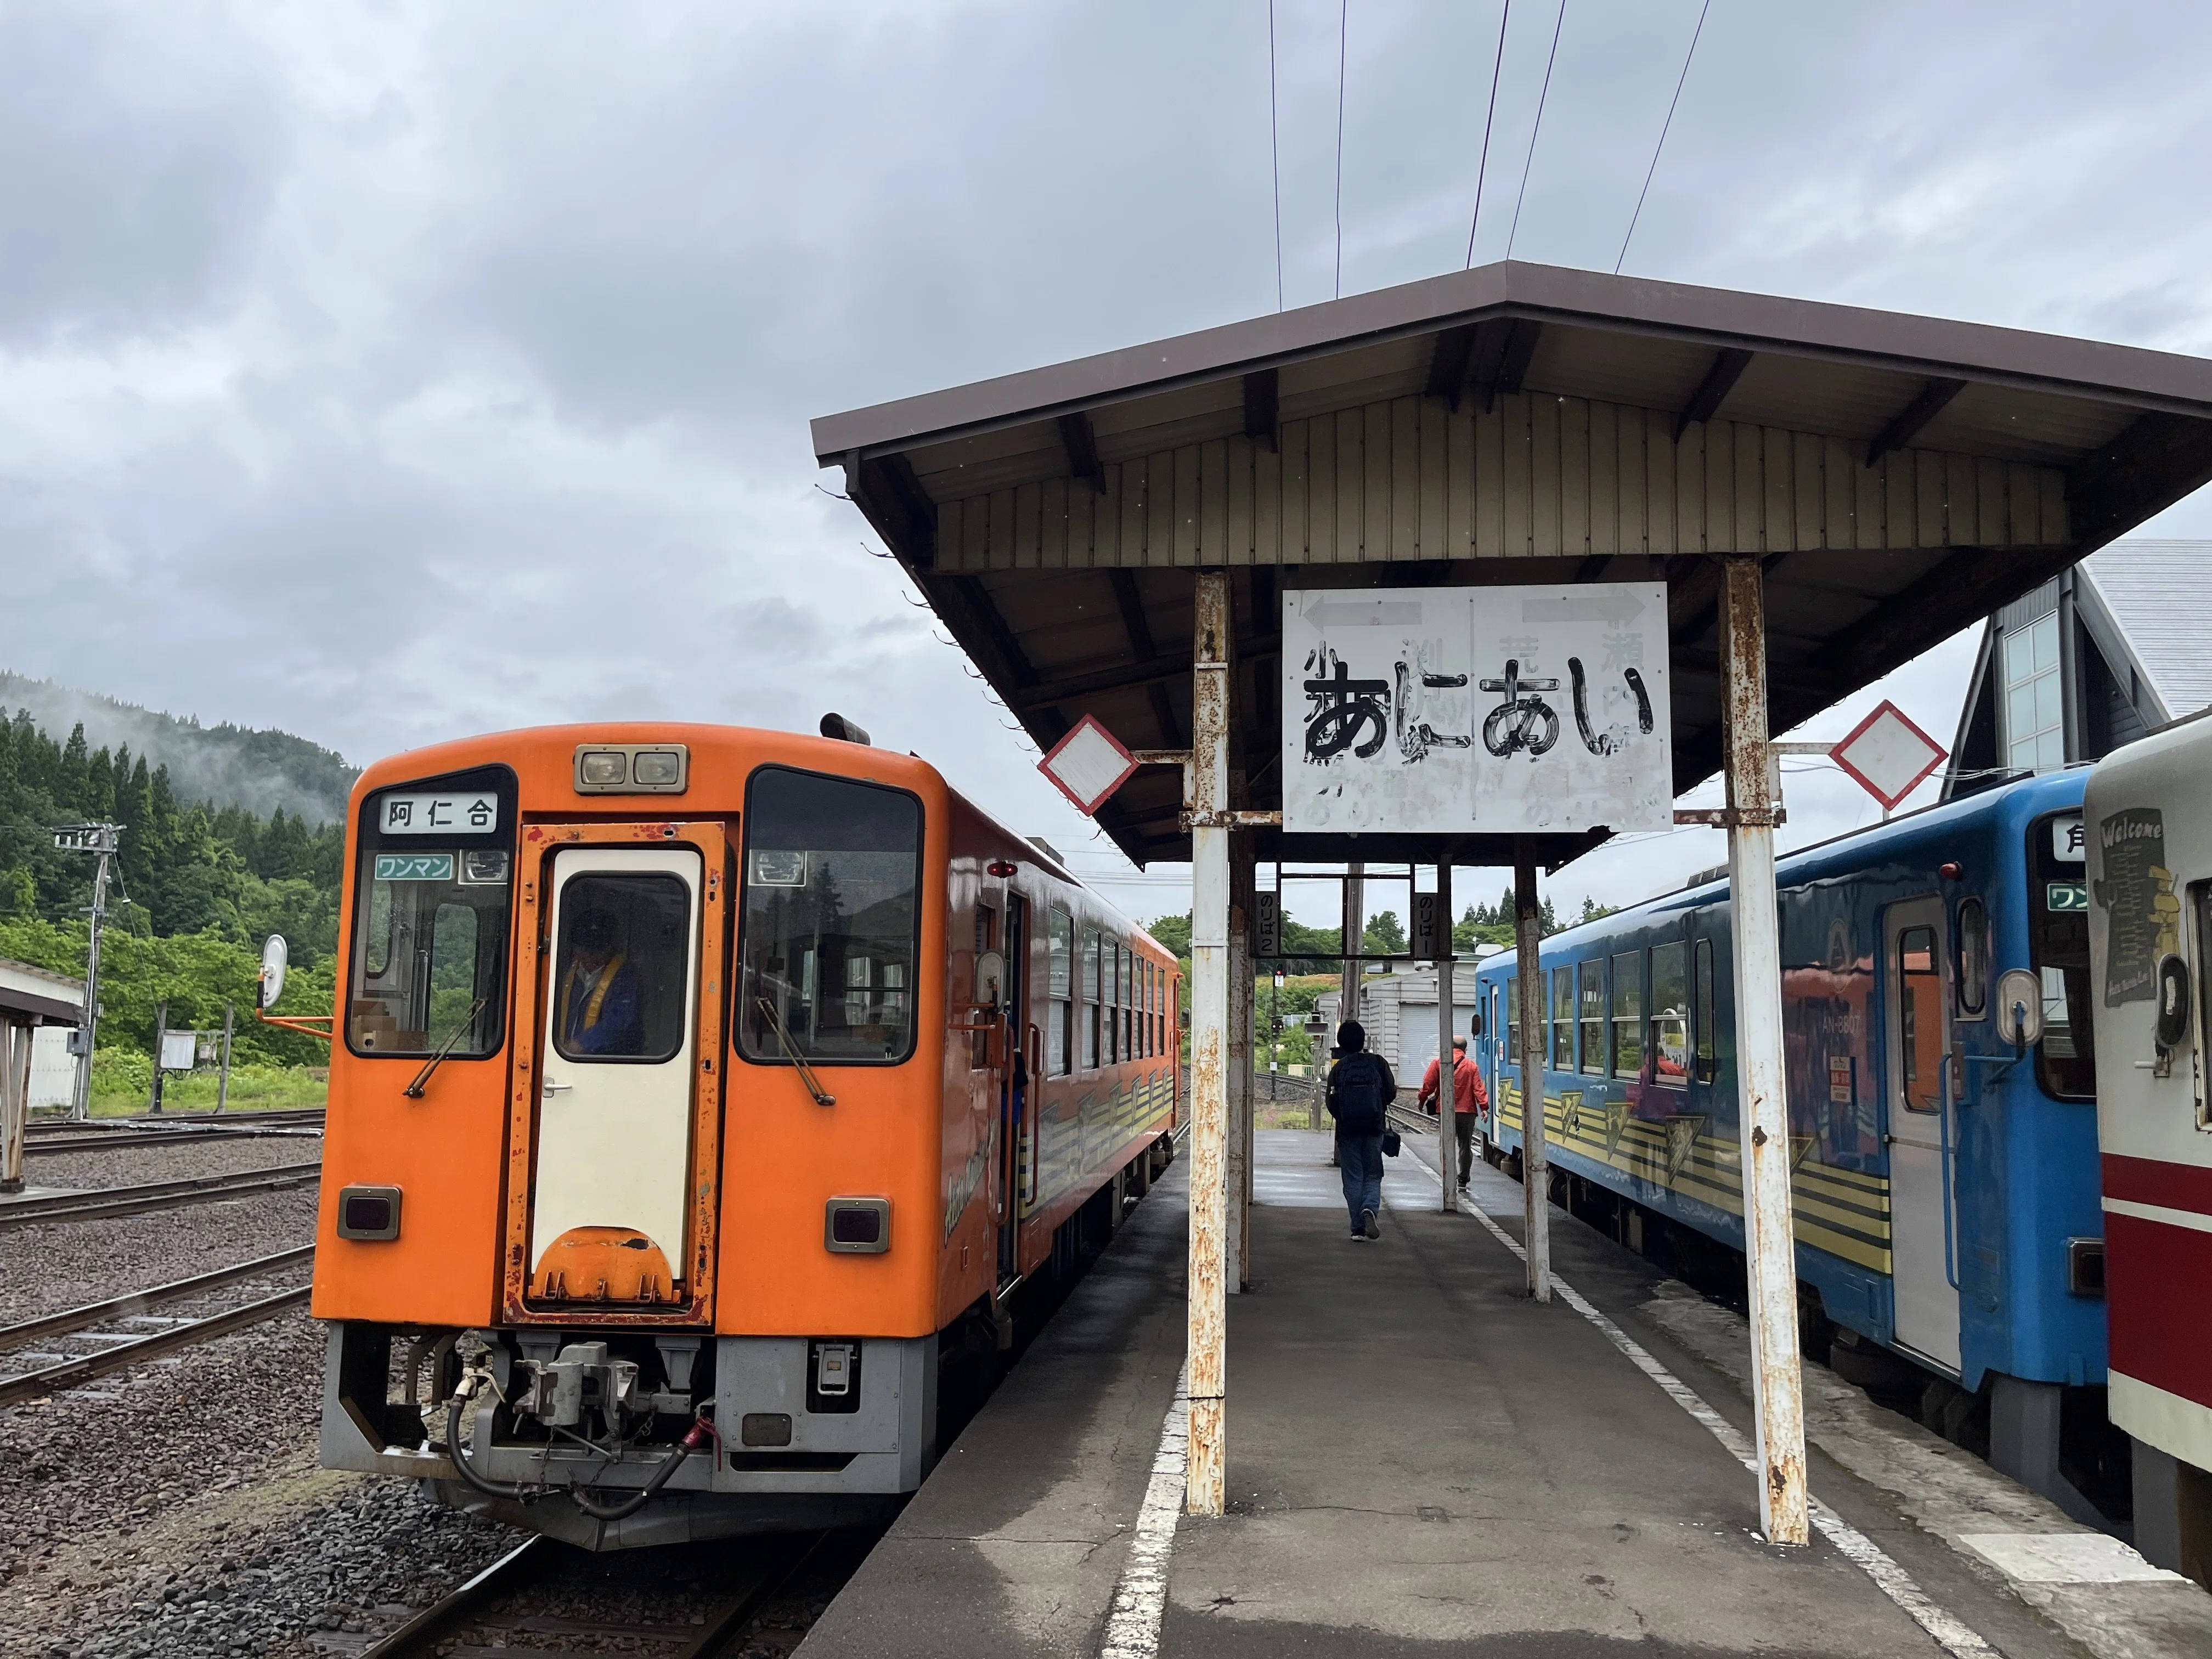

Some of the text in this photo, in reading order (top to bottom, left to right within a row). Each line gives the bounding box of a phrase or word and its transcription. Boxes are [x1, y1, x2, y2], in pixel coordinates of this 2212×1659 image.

[388, 799, 493, 827] 阿仁合
[2101, 816, 2163, 849] Welcome
[378, 857, 450, 878] ワンマン
